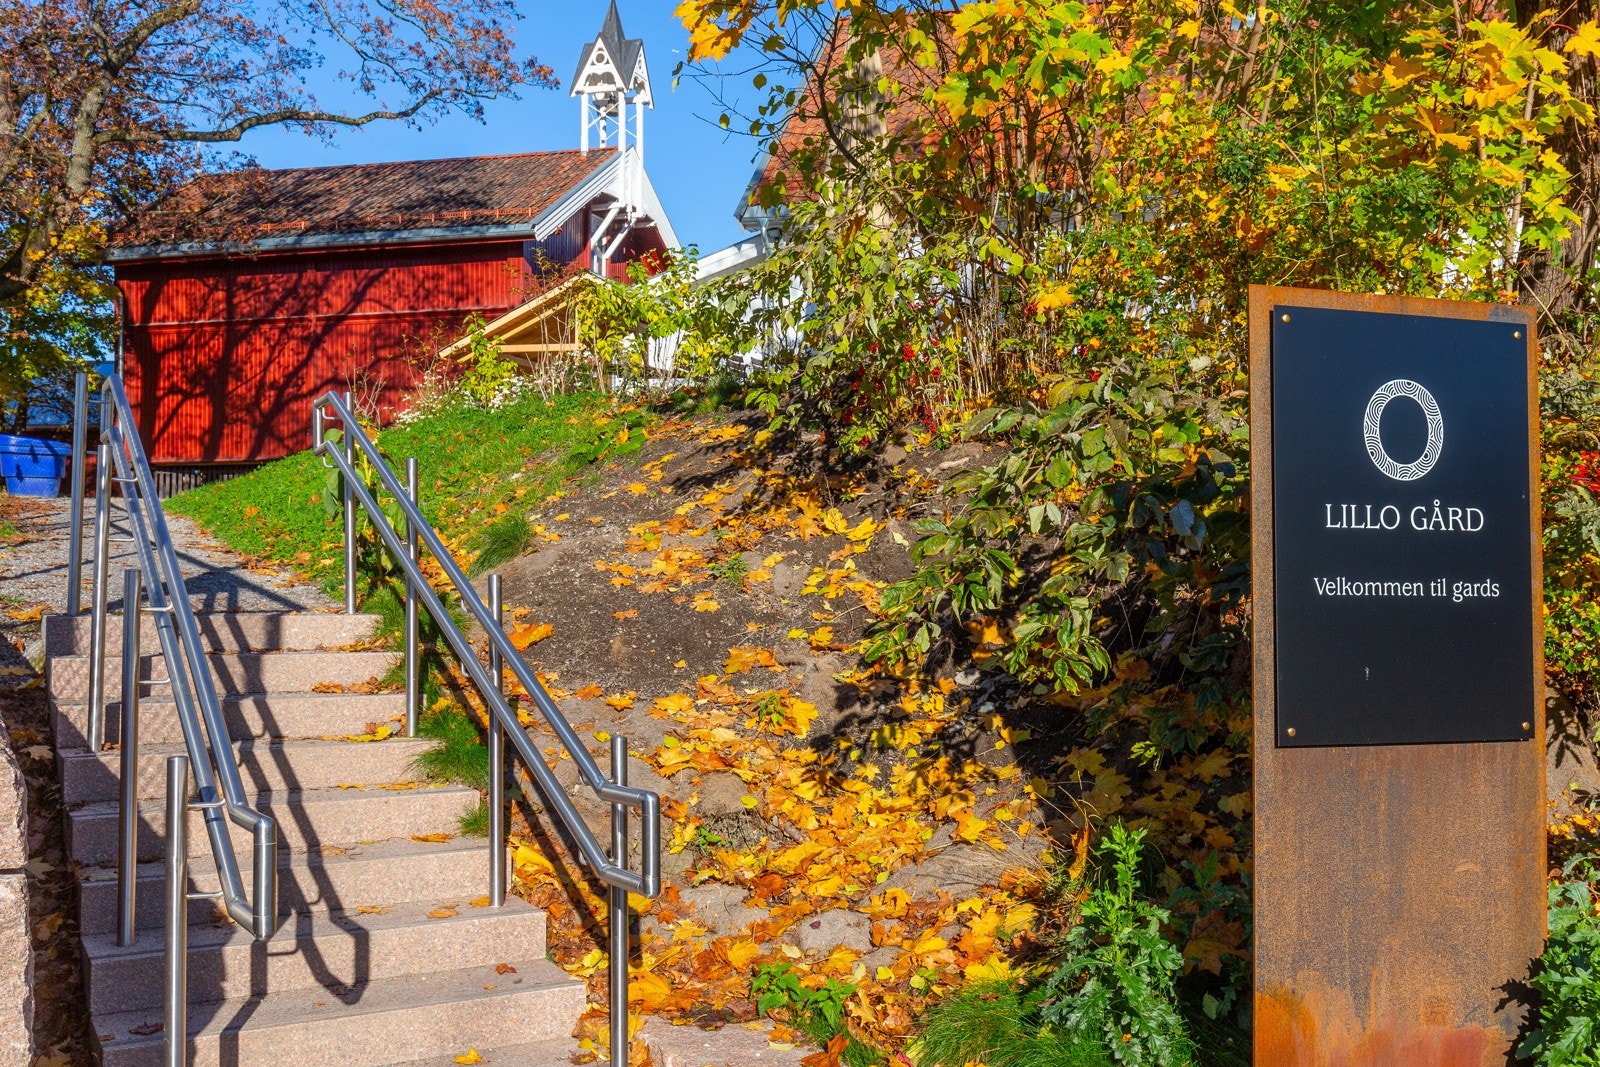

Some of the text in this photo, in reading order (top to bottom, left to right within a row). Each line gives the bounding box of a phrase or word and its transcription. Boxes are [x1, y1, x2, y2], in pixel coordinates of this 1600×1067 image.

[1324, 499, 1485, 533] LILLO GÅRD
[1313, 577, 1500, 603] Velkommen til gards
